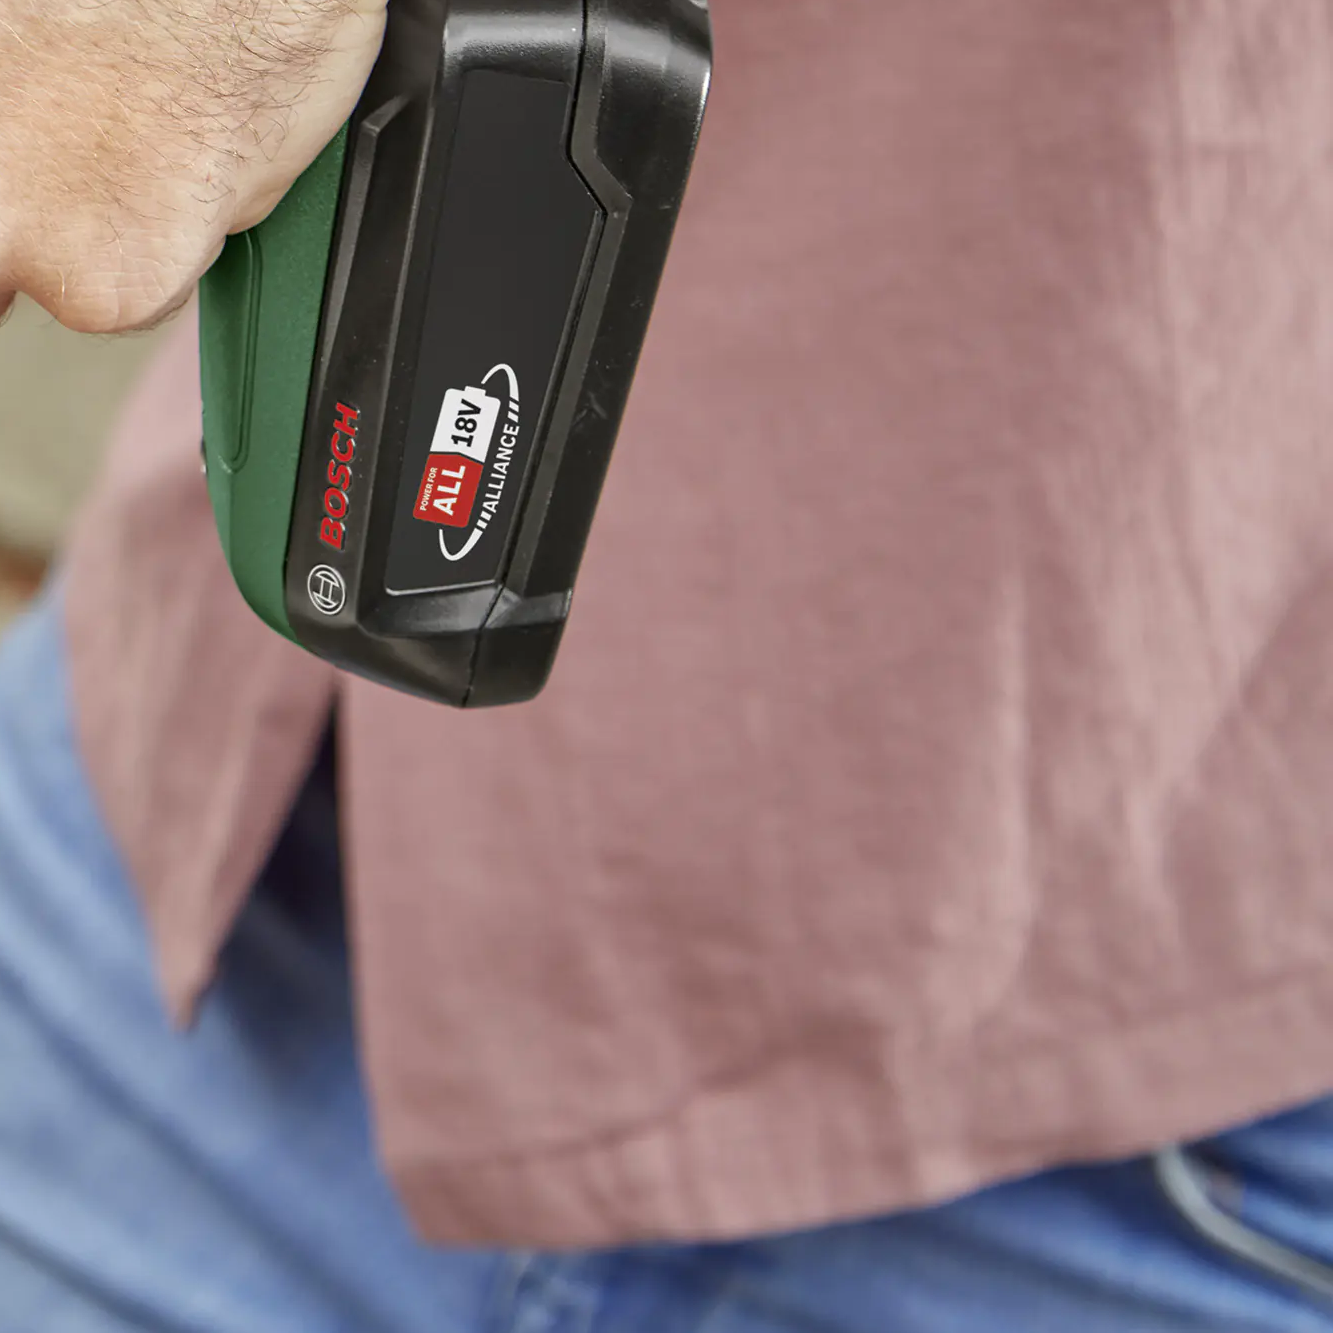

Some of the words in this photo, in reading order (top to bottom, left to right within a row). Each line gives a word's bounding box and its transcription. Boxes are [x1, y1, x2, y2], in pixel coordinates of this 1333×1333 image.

[451, 398, 482, 448] 18V
[319, 402, 360, 550] BOSCH
[419, 482, 433, 511] POWER
[427, 467, 438, 483] FOR
[433, 464, 466, 516] ALL
[482, 422, 519, 513] ALLIANCE
